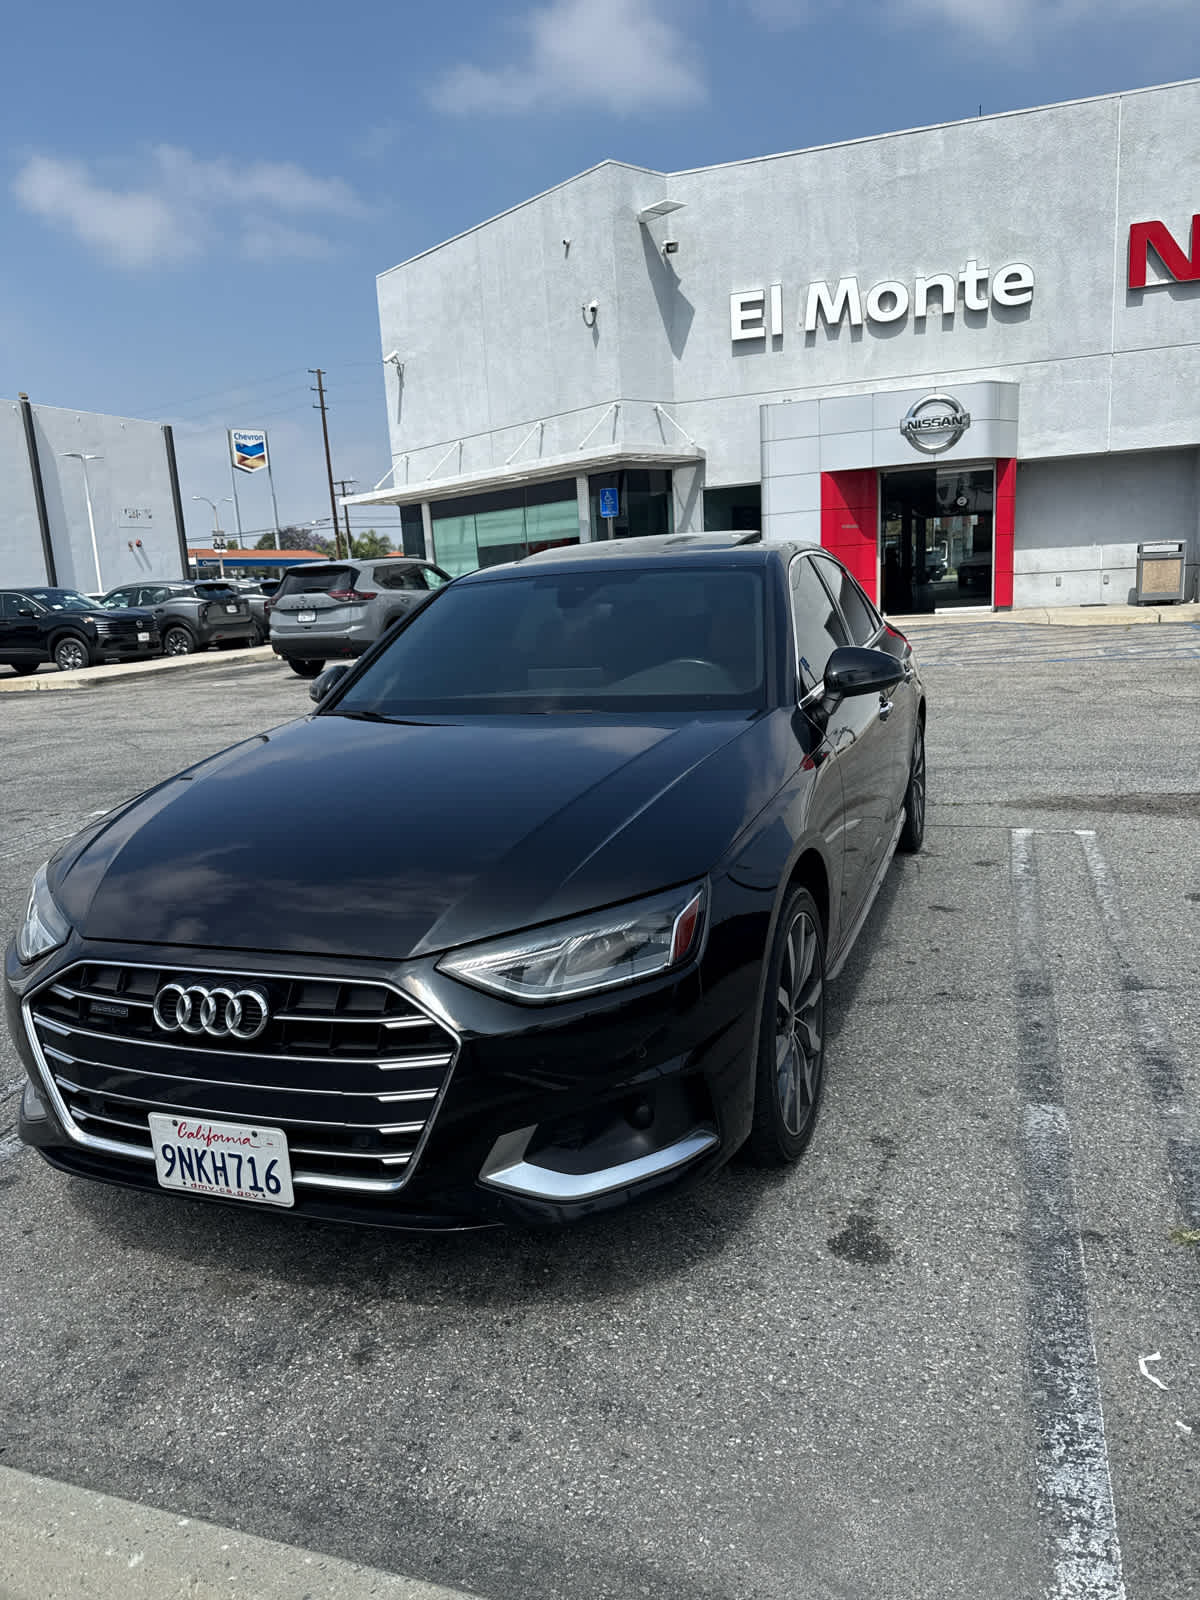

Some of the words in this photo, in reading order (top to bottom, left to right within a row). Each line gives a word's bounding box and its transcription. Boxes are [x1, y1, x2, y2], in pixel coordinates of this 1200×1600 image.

[730, 281, 783, 341] El
[805, 259, 1035, 331] Monte
[907, 415, 963, 430] NISSAN
[233, 432, 264, 441] Chevron
[177, 1121, 261, 1148] California
[161, 1143, 282, 1195] 9NKH716
[190, 1182, 259, 1199] dmv.ca.gov
